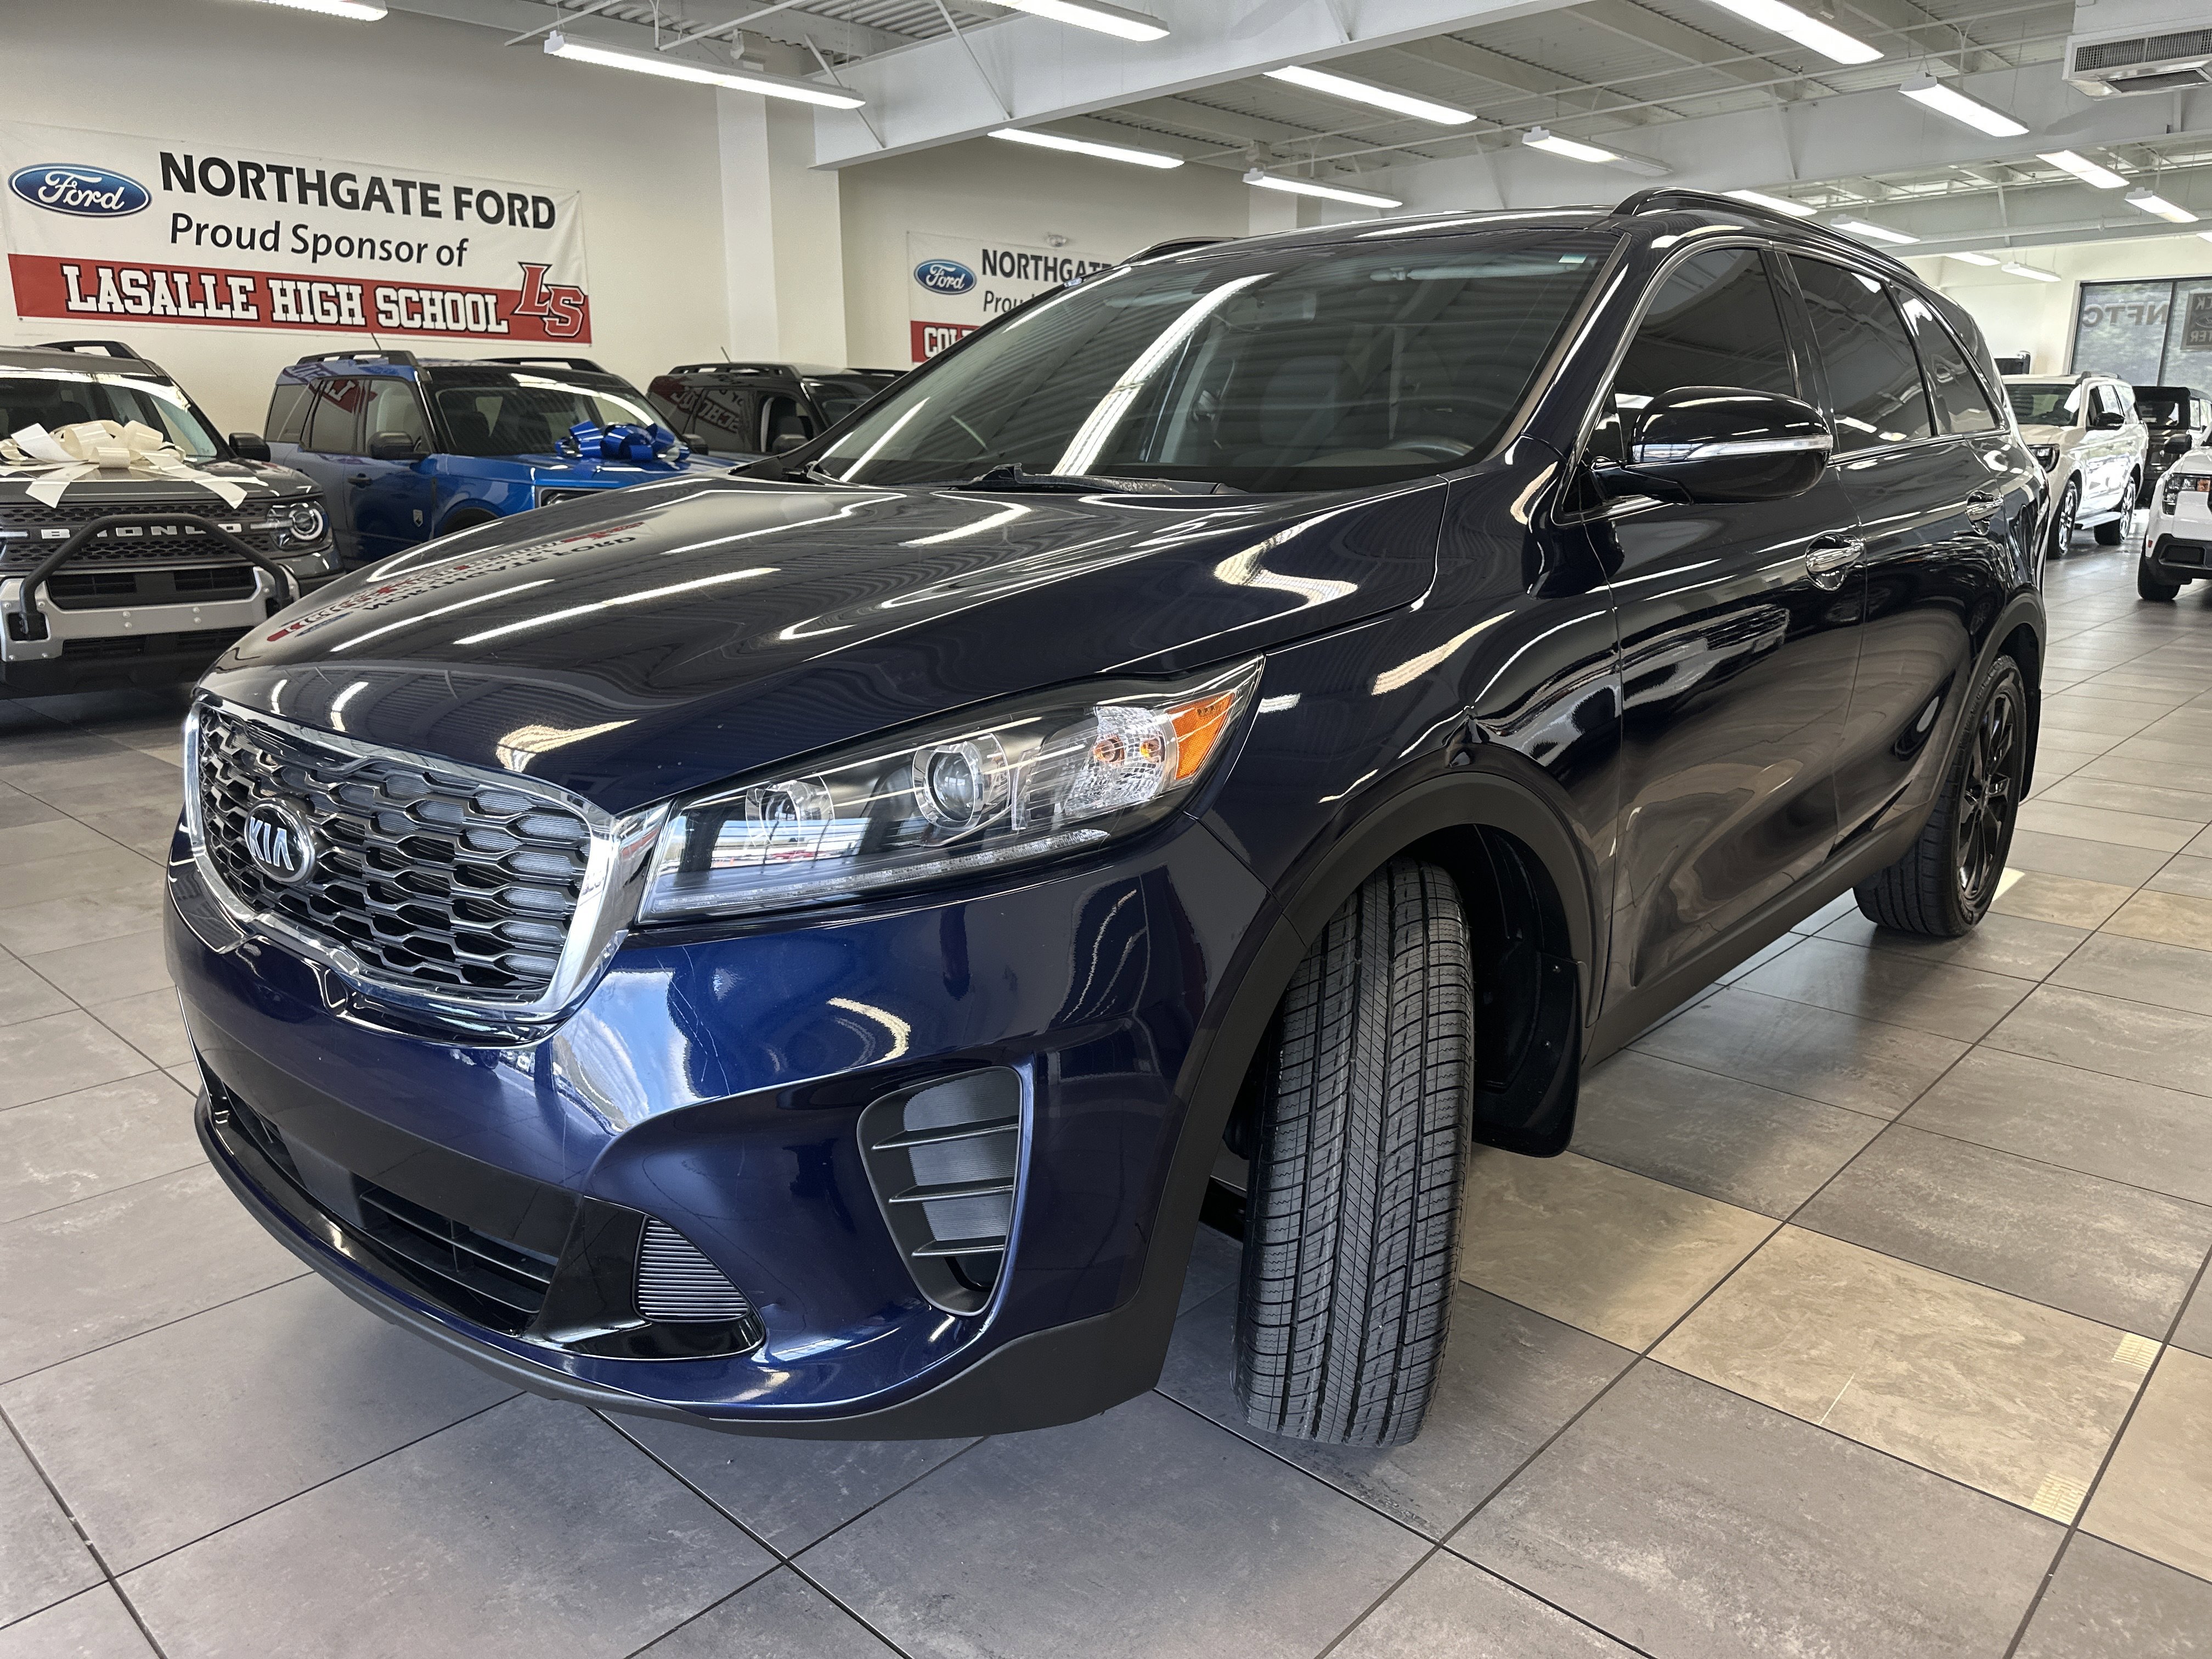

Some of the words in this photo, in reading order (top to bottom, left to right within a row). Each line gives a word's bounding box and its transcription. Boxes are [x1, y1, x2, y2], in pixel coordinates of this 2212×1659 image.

[160, 151, 442, 218] NORTHGATE
[453, 186, 556, 229] FORD
[171, 213, 281, 252] Proud
[291, 223, 428, 263] Sponsor
[436, 238, 469, 267] of
[60, 263, 260, 321] LASALLE
[267, 278, 366, 327] HIGH
[374, 286, 510, 334] SCHOOL
[983, 290, 1035, 313] Pro
[923, 325, 978, 358] CO
[249, 816, 295, 871] KIA
